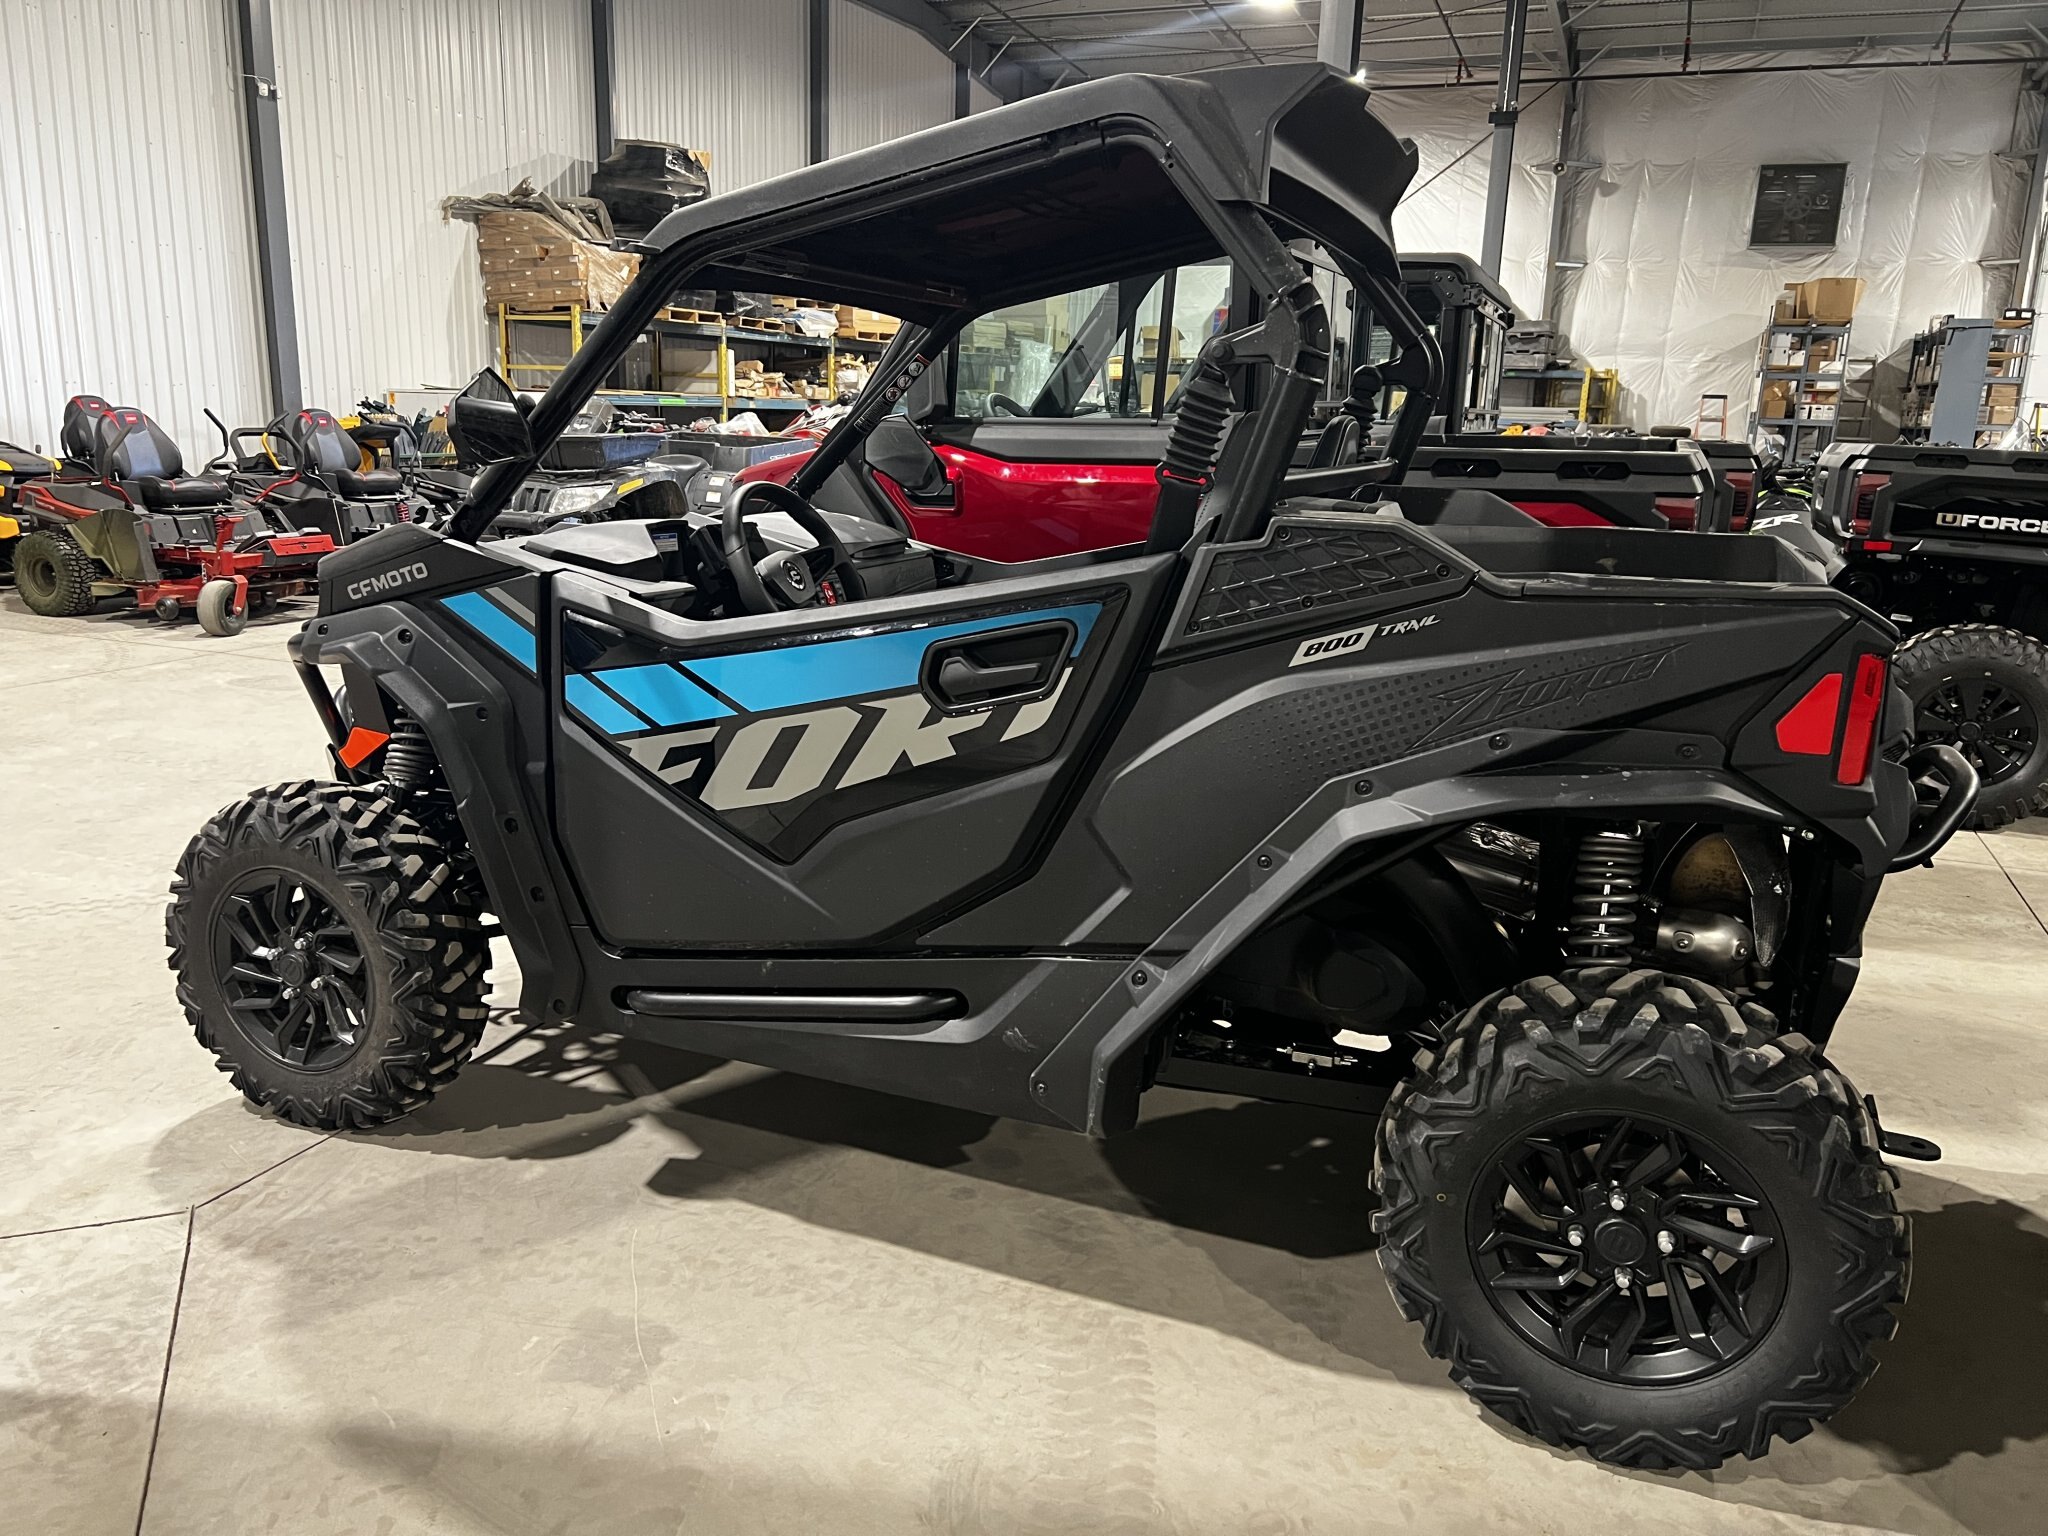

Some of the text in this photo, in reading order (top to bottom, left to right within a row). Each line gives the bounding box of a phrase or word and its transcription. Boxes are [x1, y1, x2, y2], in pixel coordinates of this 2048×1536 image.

[1936, 513, 2048, 533] UFORCE
[347, 562, 429, 600] CFMOTO
[1303, 614, 1441, 657] 800 TRAIL
